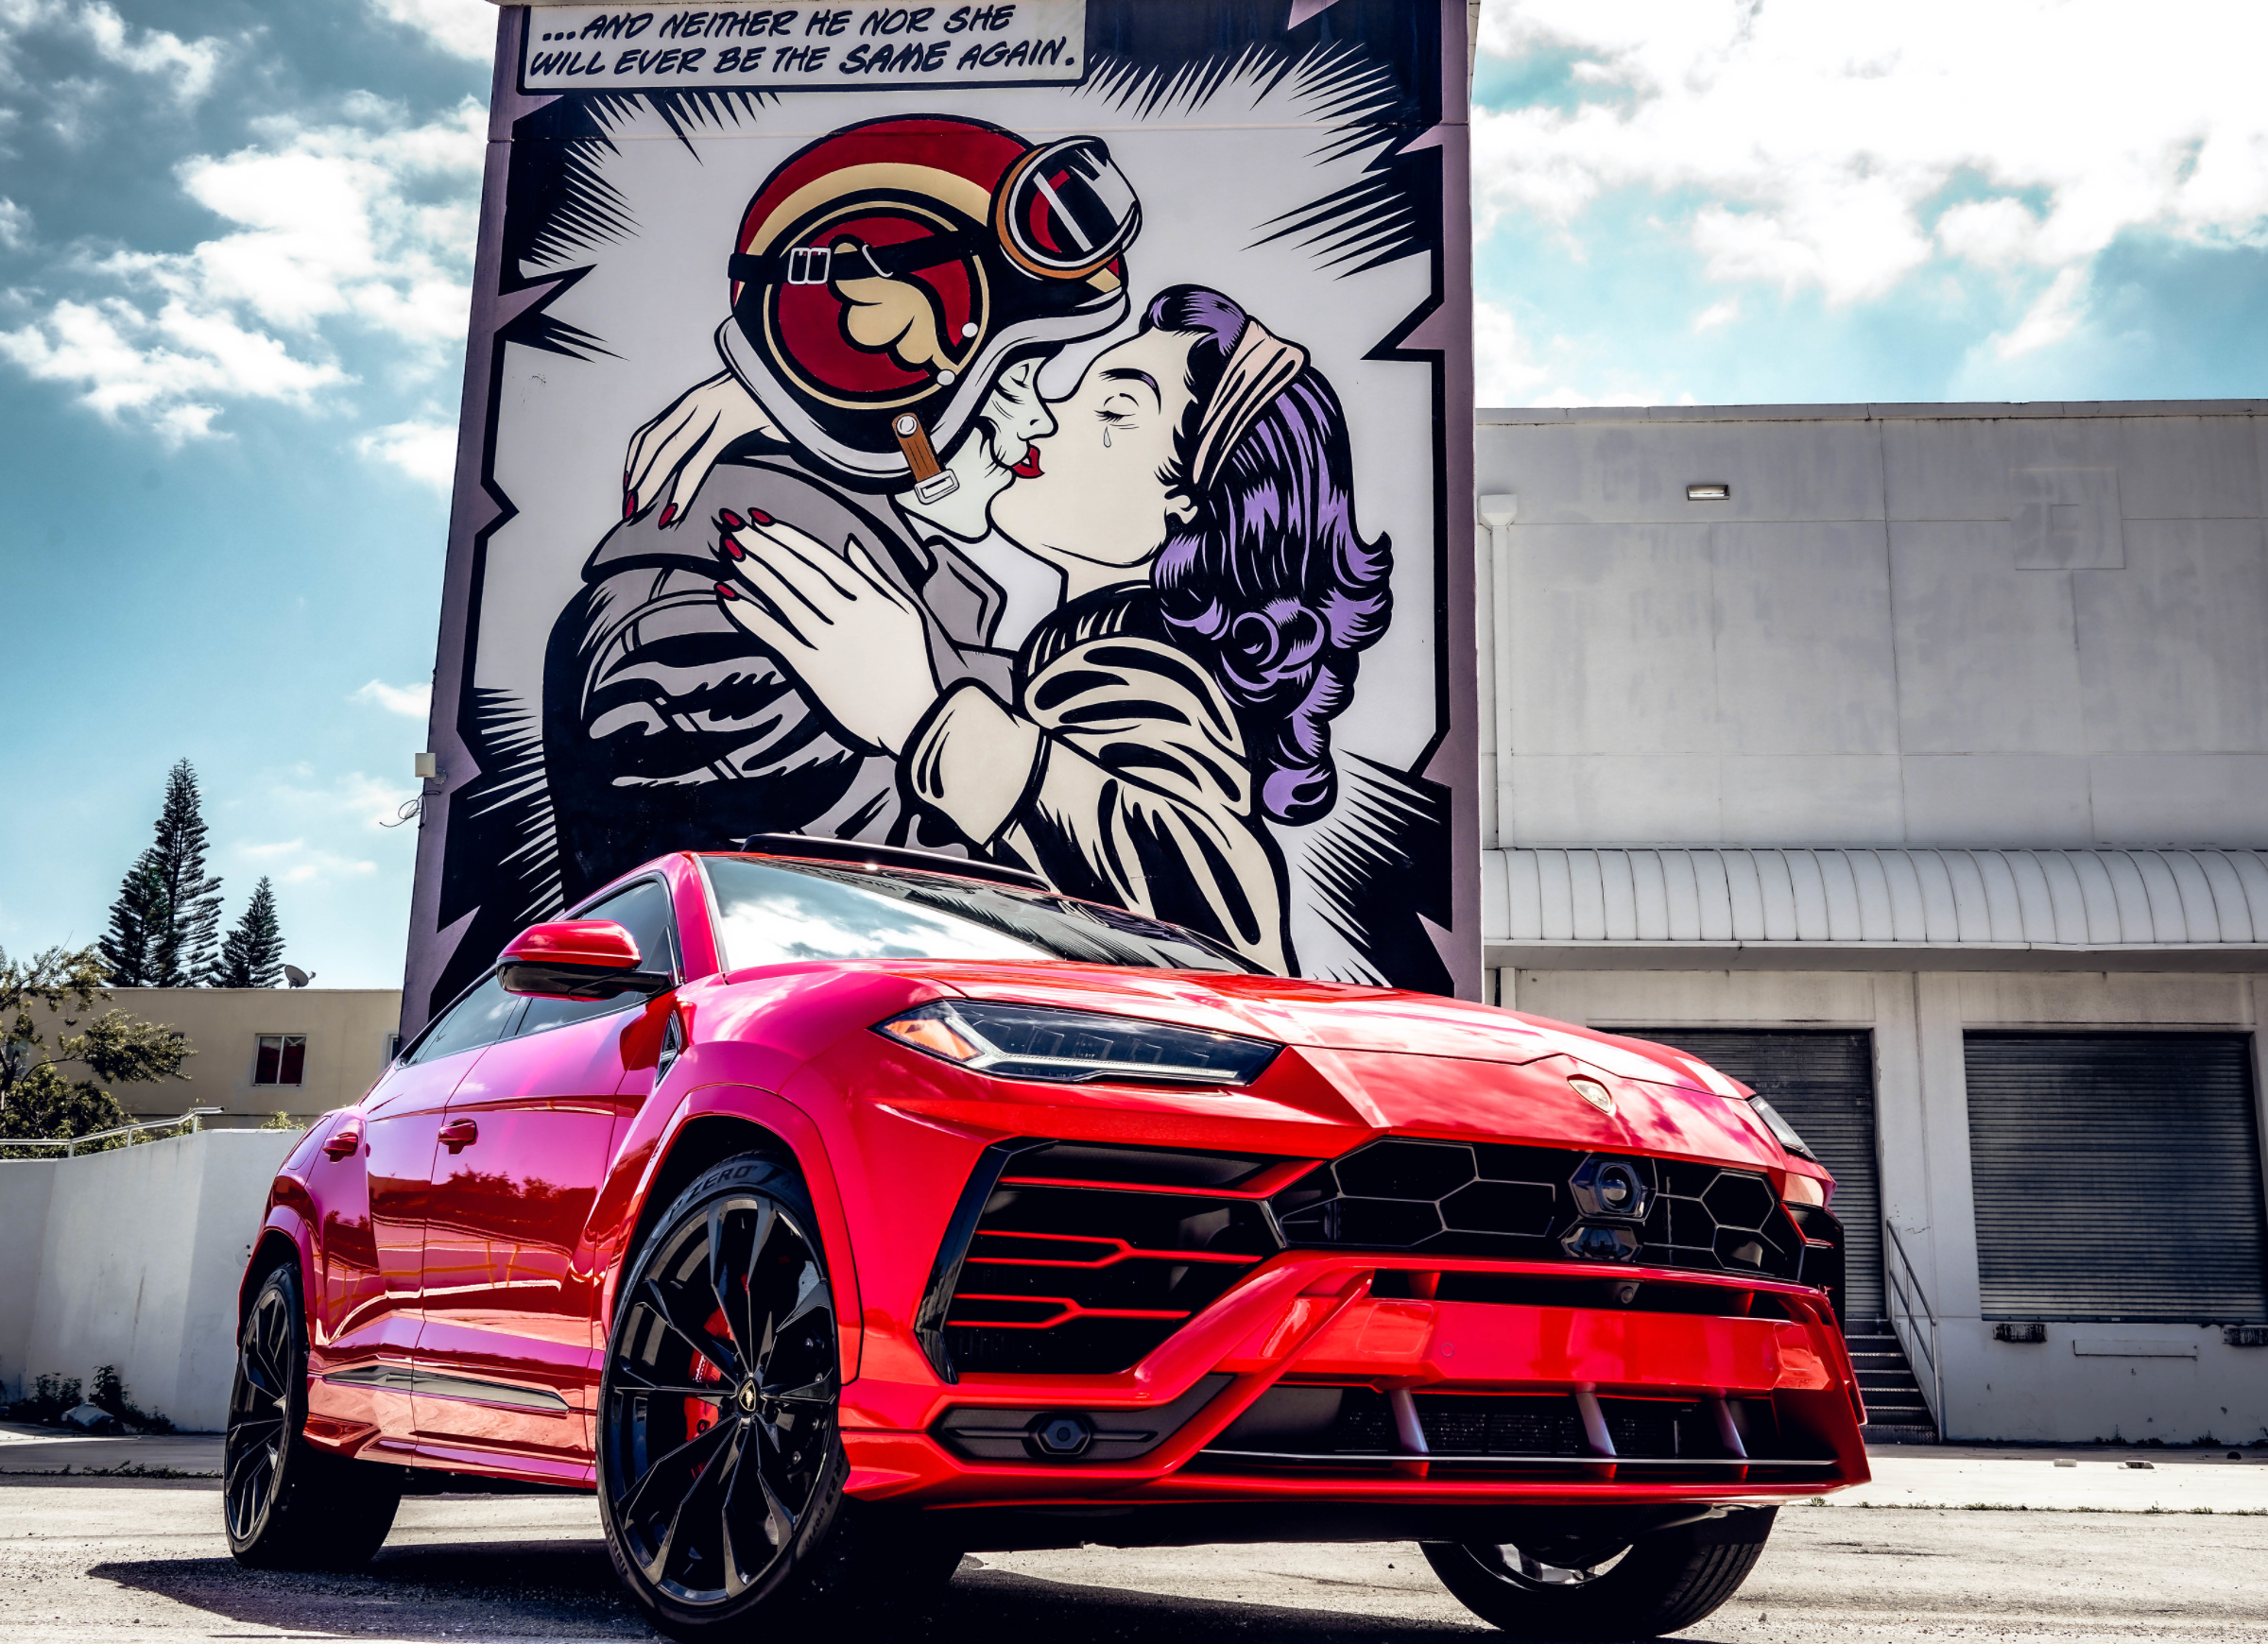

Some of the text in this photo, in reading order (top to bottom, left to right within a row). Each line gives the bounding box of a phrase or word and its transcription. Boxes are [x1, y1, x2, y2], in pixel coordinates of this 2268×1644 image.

[541, 5, 1017, 42] ...AND NEITHER HE NOR SHE
[529, 35, 1075, 77] WILL EVER BE THE SAME AGAIN.
[668, 1165, 755, 1222] P ZERO
